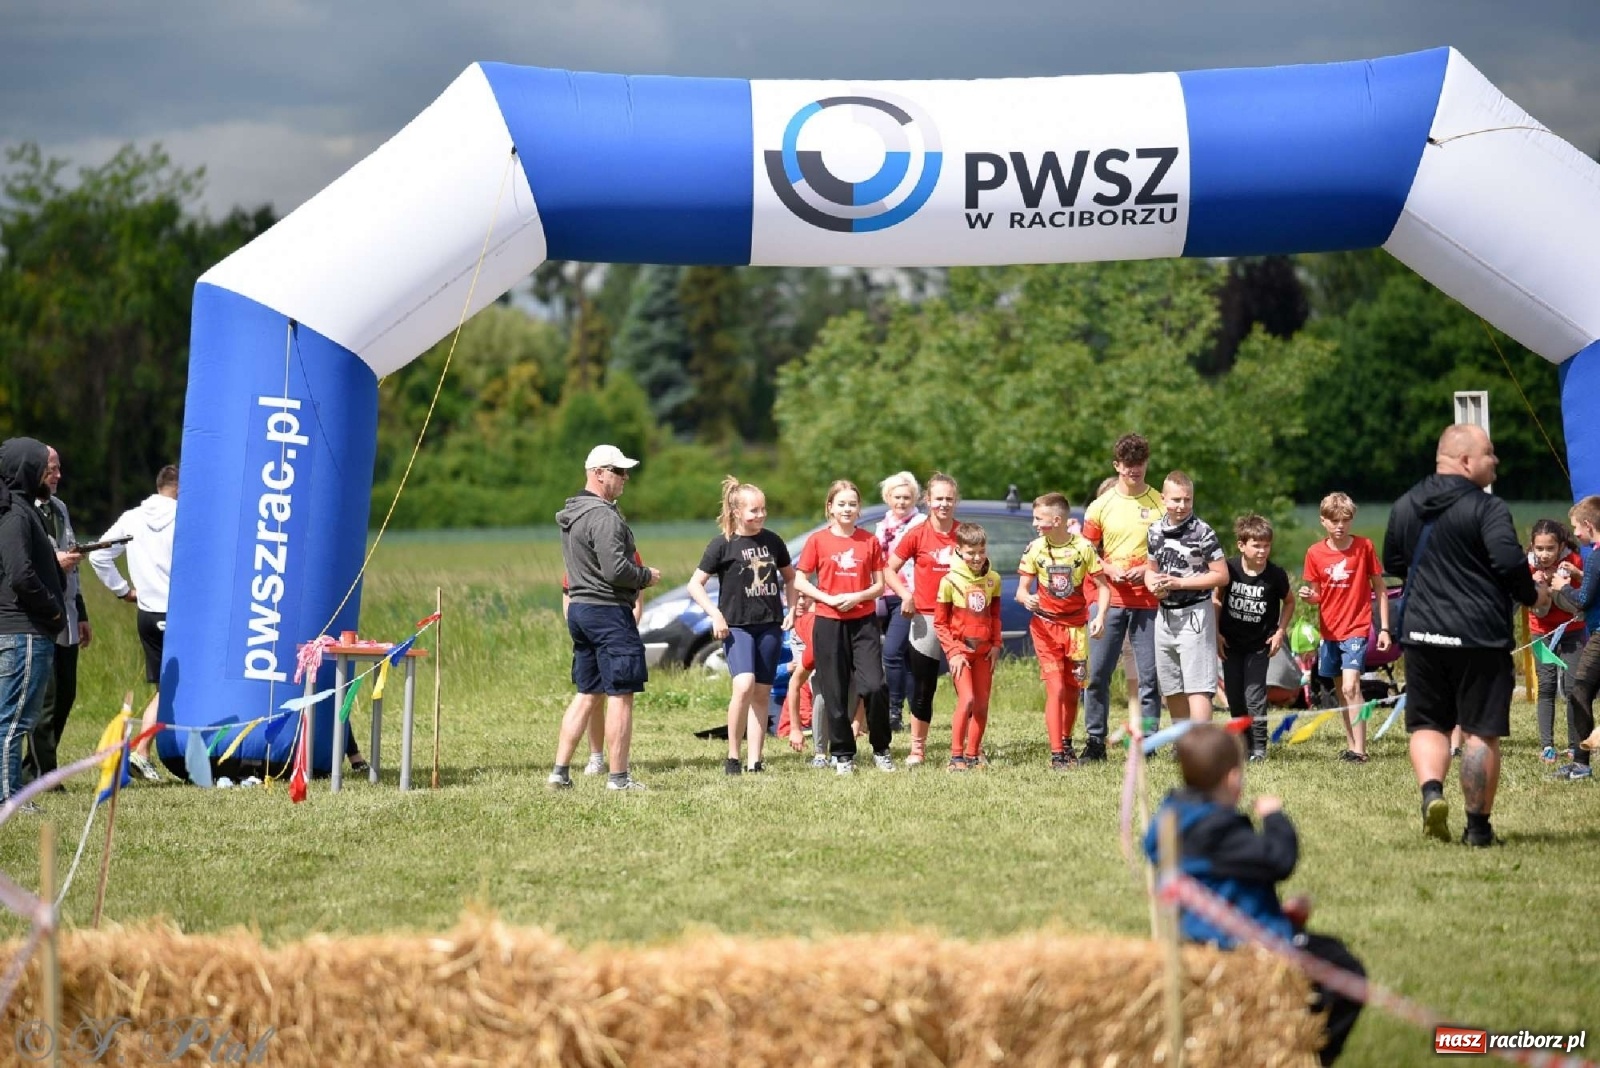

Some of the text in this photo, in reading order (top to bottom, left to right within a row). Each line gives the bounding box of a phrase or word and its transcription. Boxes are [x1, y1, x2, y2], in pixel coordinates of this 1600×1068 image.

[964, 147, 1179, 210] PWSZ
[965, 207, 1178, 229] W RACIBORZU
[244, 396, 309, 683] pwszrac.pl
[741, 545, 771, 561] HELLO
[744, 582, 778, 598] WORLD
[1230, 580, 1265, 598] MUSIC
